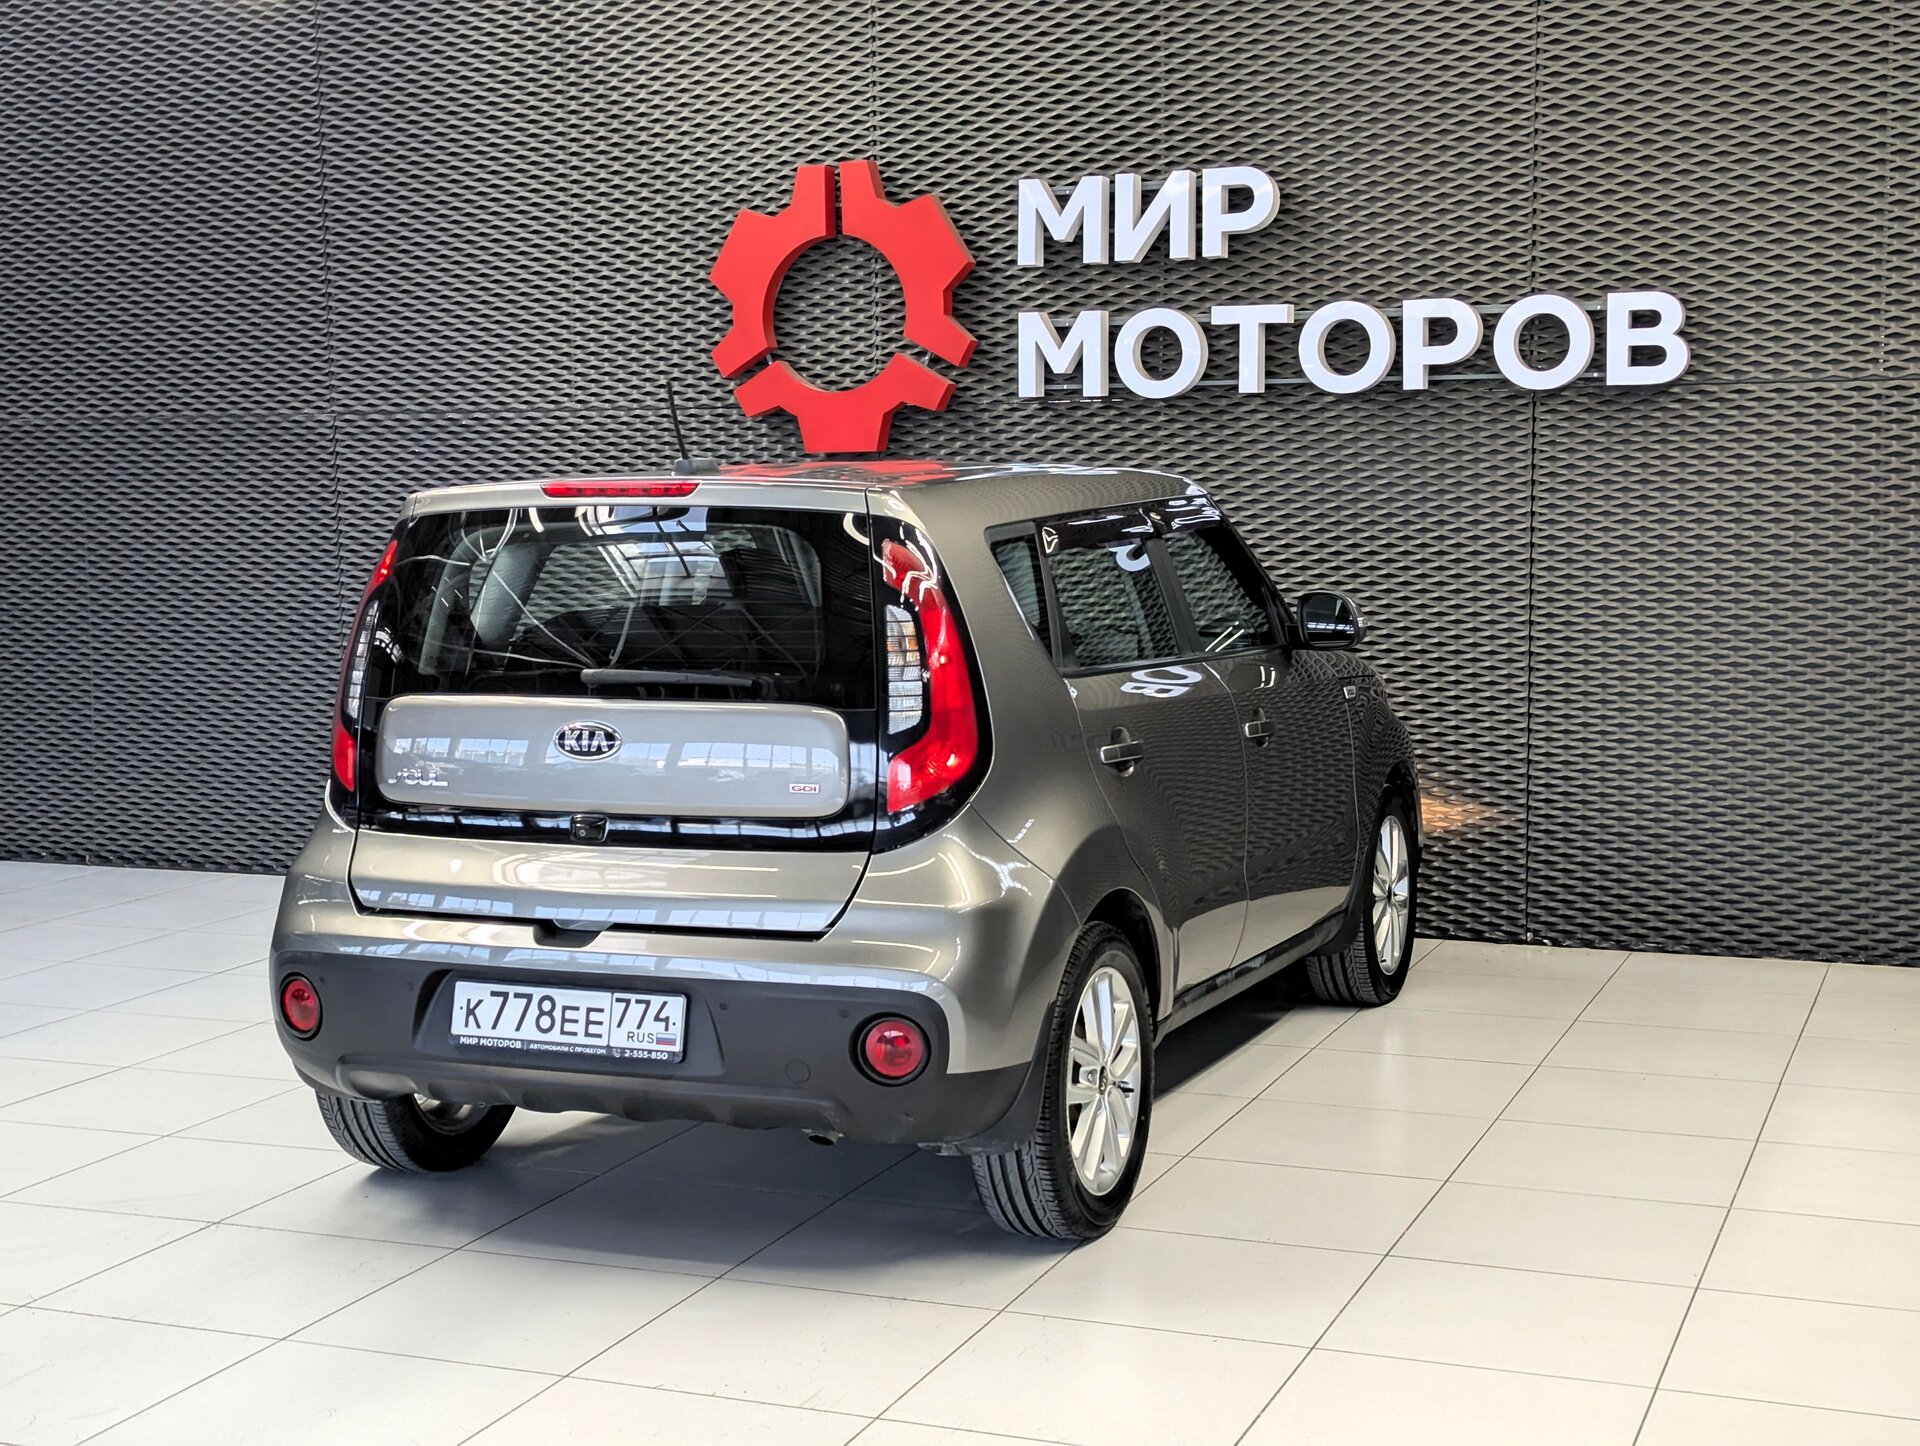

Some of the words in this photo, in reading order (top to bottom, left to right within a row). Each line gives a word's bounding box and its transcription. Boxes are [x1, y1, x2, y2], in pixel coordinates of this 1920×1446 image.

[1017, 166, 1281, 266] МИР
[1017, 291, 1691, 399] МОТОРОВ
[564, 730, 609, 751] KIA
[614, 997, 670, 1032] 774
[459, 1036, 478, 1045] МИР
[480, 1038, 522, 1049] МОТОРОВ
[529, 1043, 569, 1052] АВТОМОБИЛИ
[574, 1047, 606, 1055] ПРОБЕГОМ
[624, 1049, 669, 1060] 2-555-850
[627, 1031, 655, 1044] RUS
